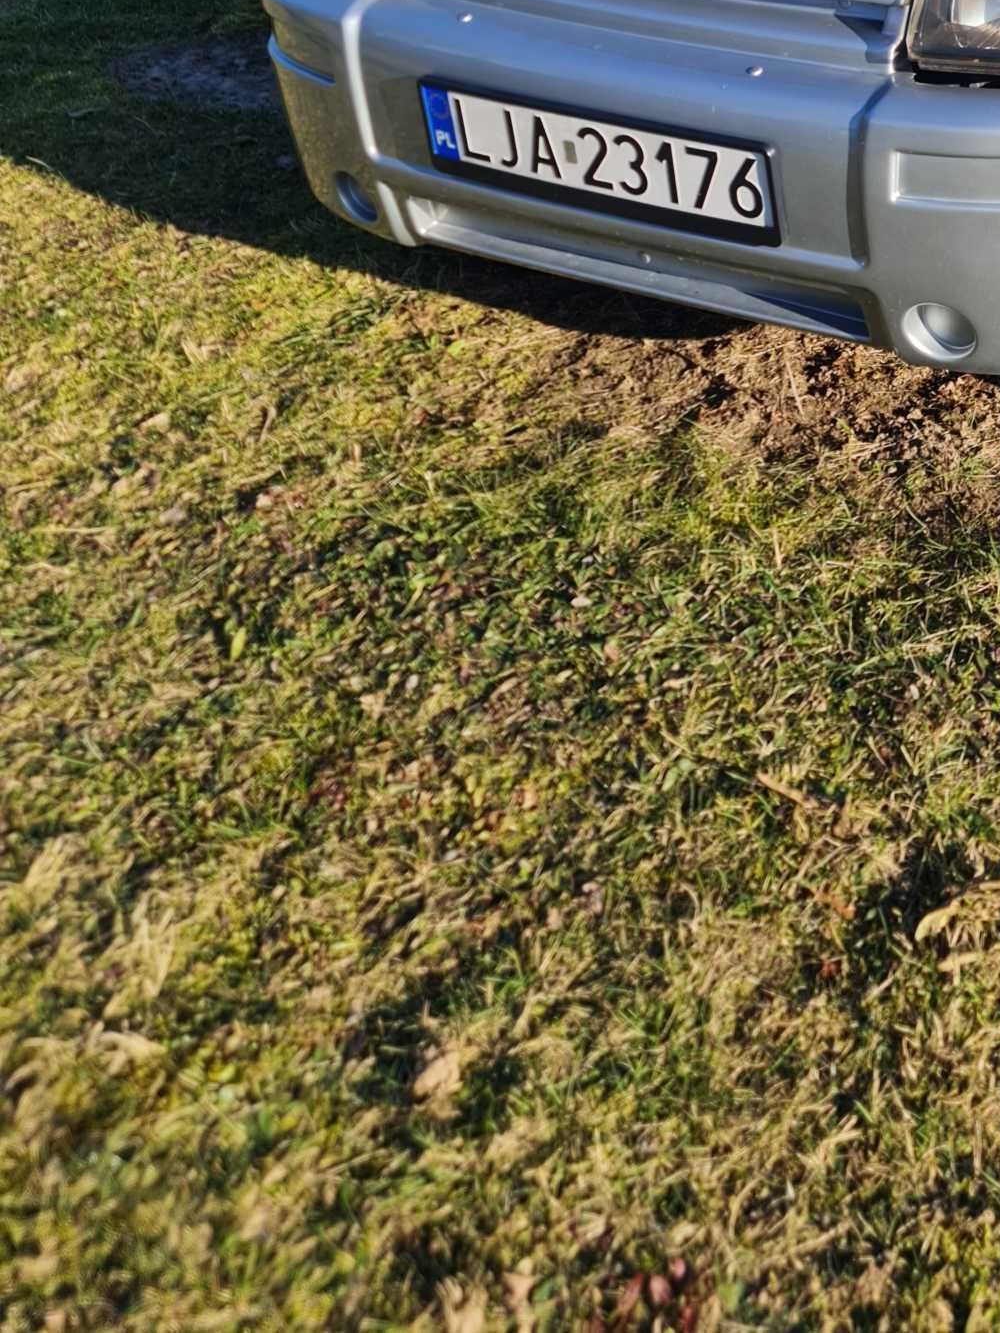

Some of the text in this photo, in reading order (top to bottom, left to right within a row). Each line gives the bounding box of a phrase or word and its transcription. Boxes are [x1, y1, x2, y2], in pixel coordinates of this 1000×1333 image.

[436, 129, 456, 150] PL
[453, 99, 763, 219] LJA 23176
